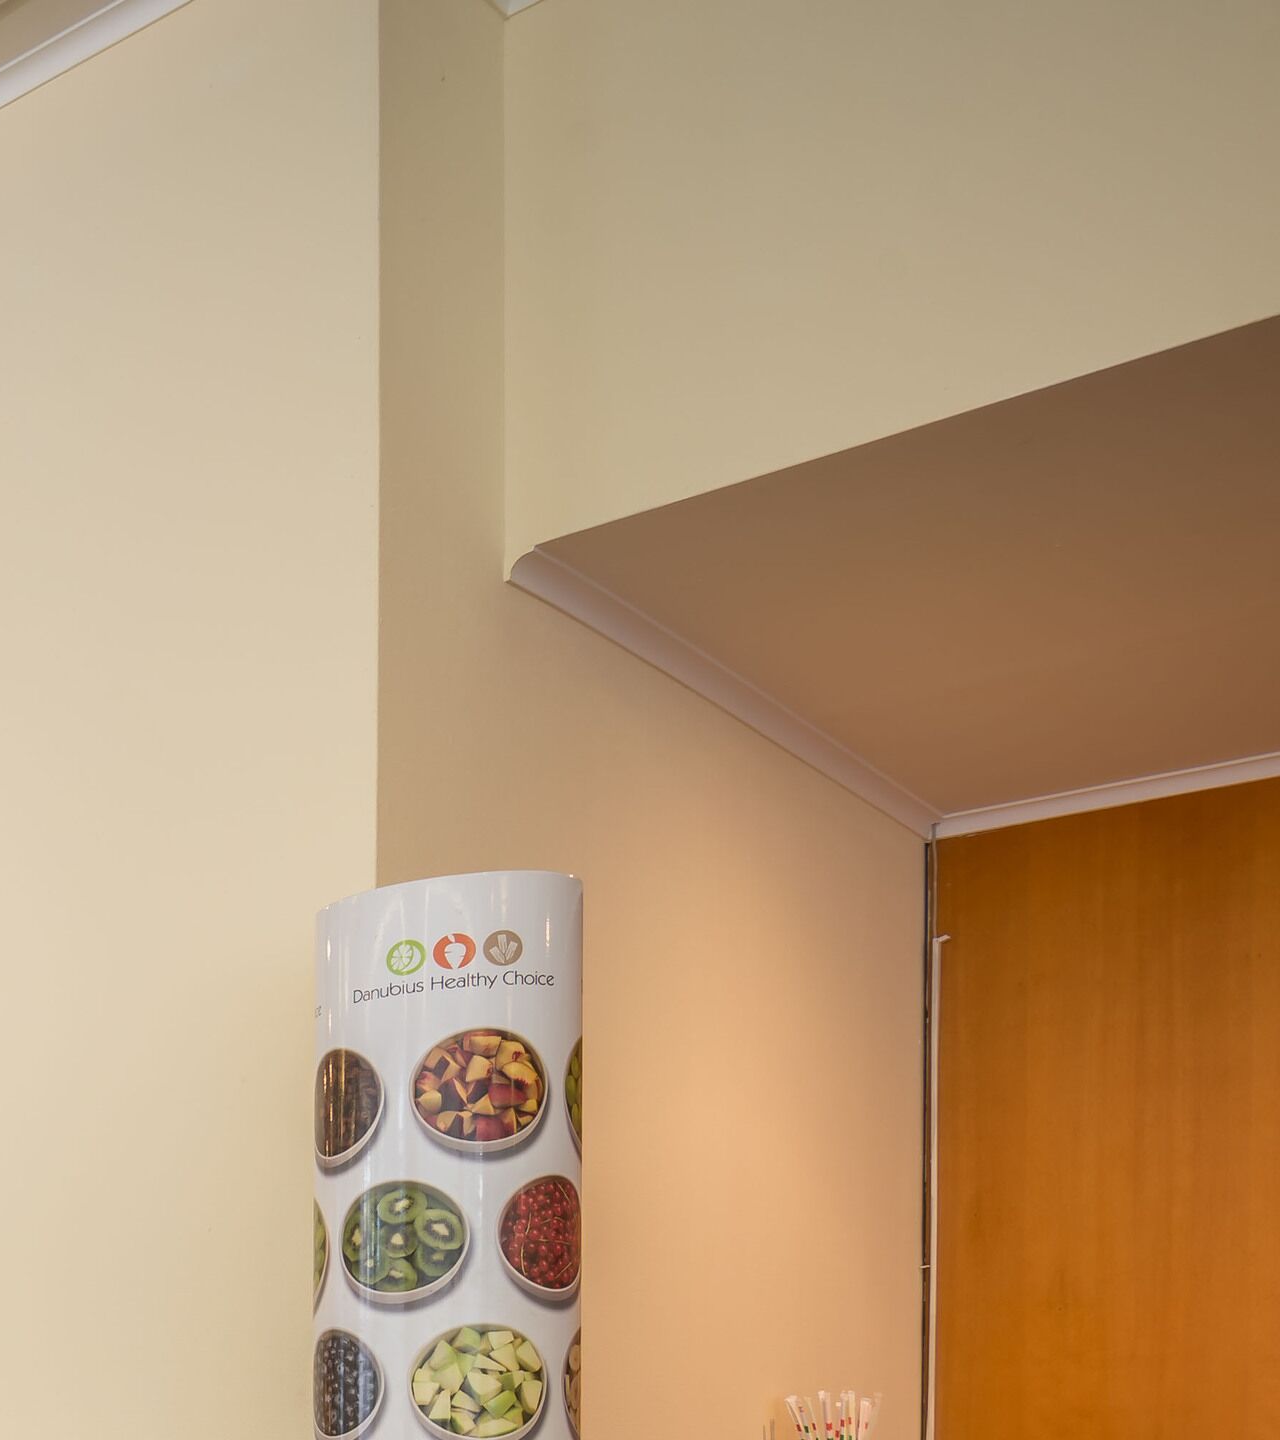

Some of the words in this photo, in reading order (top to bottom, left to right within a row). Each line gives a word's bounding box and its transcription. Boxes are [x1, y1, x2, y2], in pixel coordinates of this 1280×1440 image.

[352, 981, 425, 1004] Danubius
[430, 972, 498, 990] Healthy
[502, 970, 555, 986] Choice
